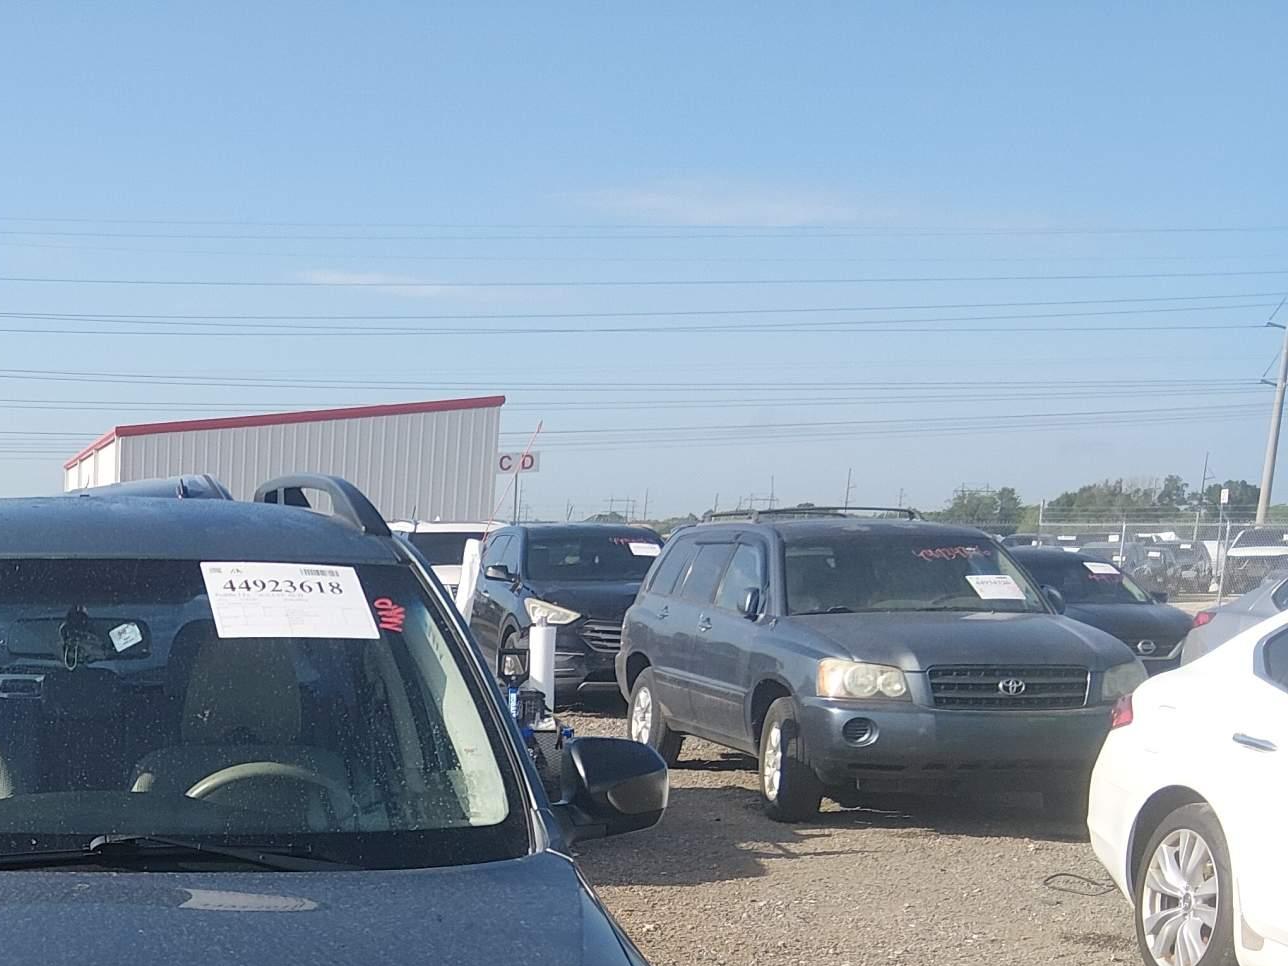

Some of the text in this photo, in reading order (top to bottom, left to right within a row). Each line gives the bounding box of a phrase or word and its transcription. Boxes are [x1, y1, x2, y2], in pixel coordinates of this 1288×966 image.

[499, 454, 534, 471] C D
[223, 579, 344, 595] 44923618
